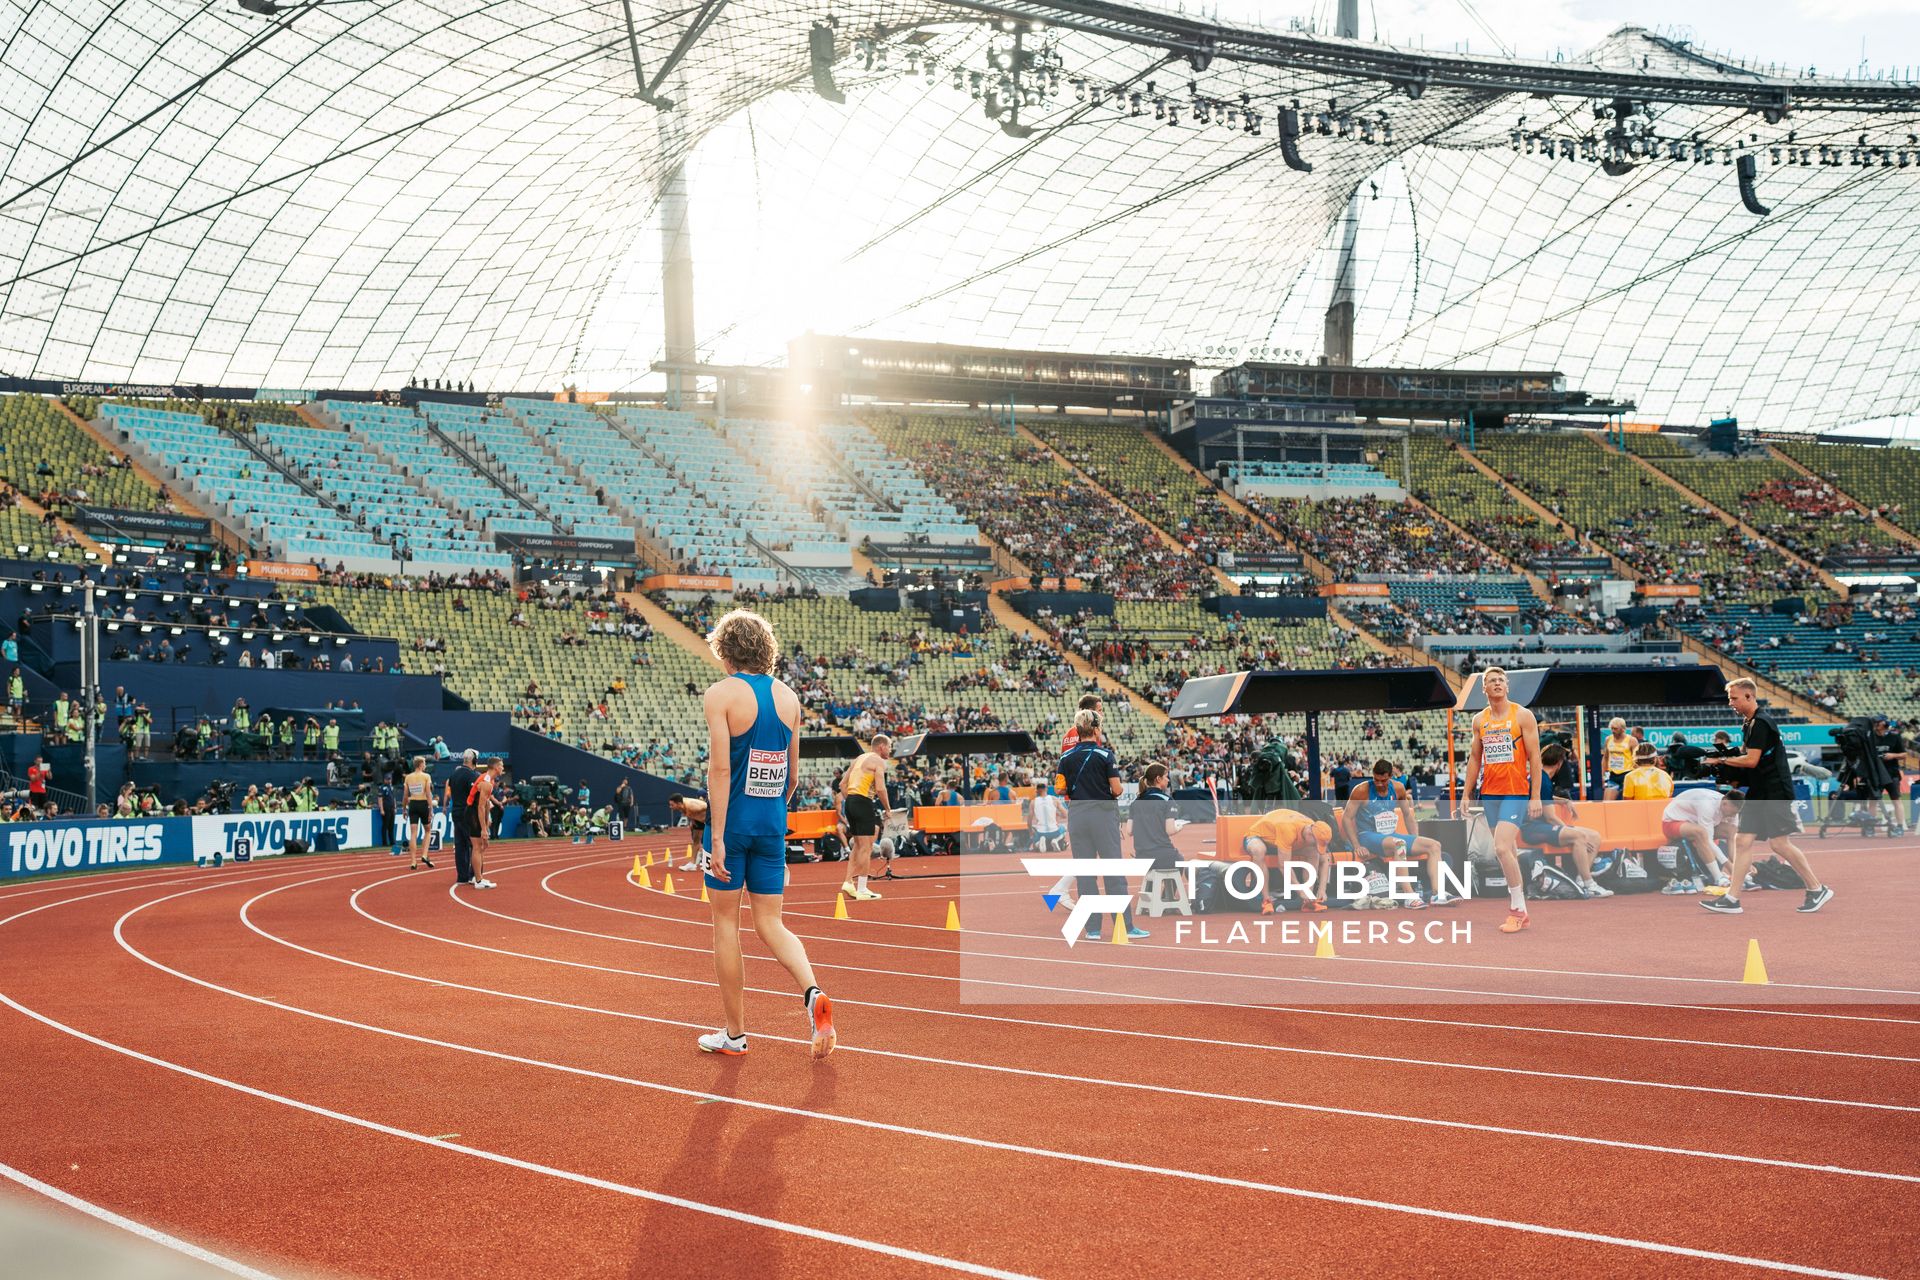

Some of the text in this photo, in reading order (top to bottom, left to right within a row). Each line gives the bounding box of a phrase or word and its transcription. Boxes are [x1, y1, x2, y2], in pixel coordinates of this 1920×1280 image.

[63, 383, 175, 396] EUROPEAN CHAMPIONSHIPS
[261, 565, 309, 577] MUNICH 2022
[678, 577, 703, 586] MUNICH
[1484, 744, 1512, 754] ROOSEN
[752, 752, 785, 763] SPAR
[748, 787, 777, 796] MUNICH
[223, 819, 286, 853] TOYO
[611, 826, 619, 836] 6
[9, 824, 163, 872] TOYO TIRES
[237, 843, 248, 856] 8
